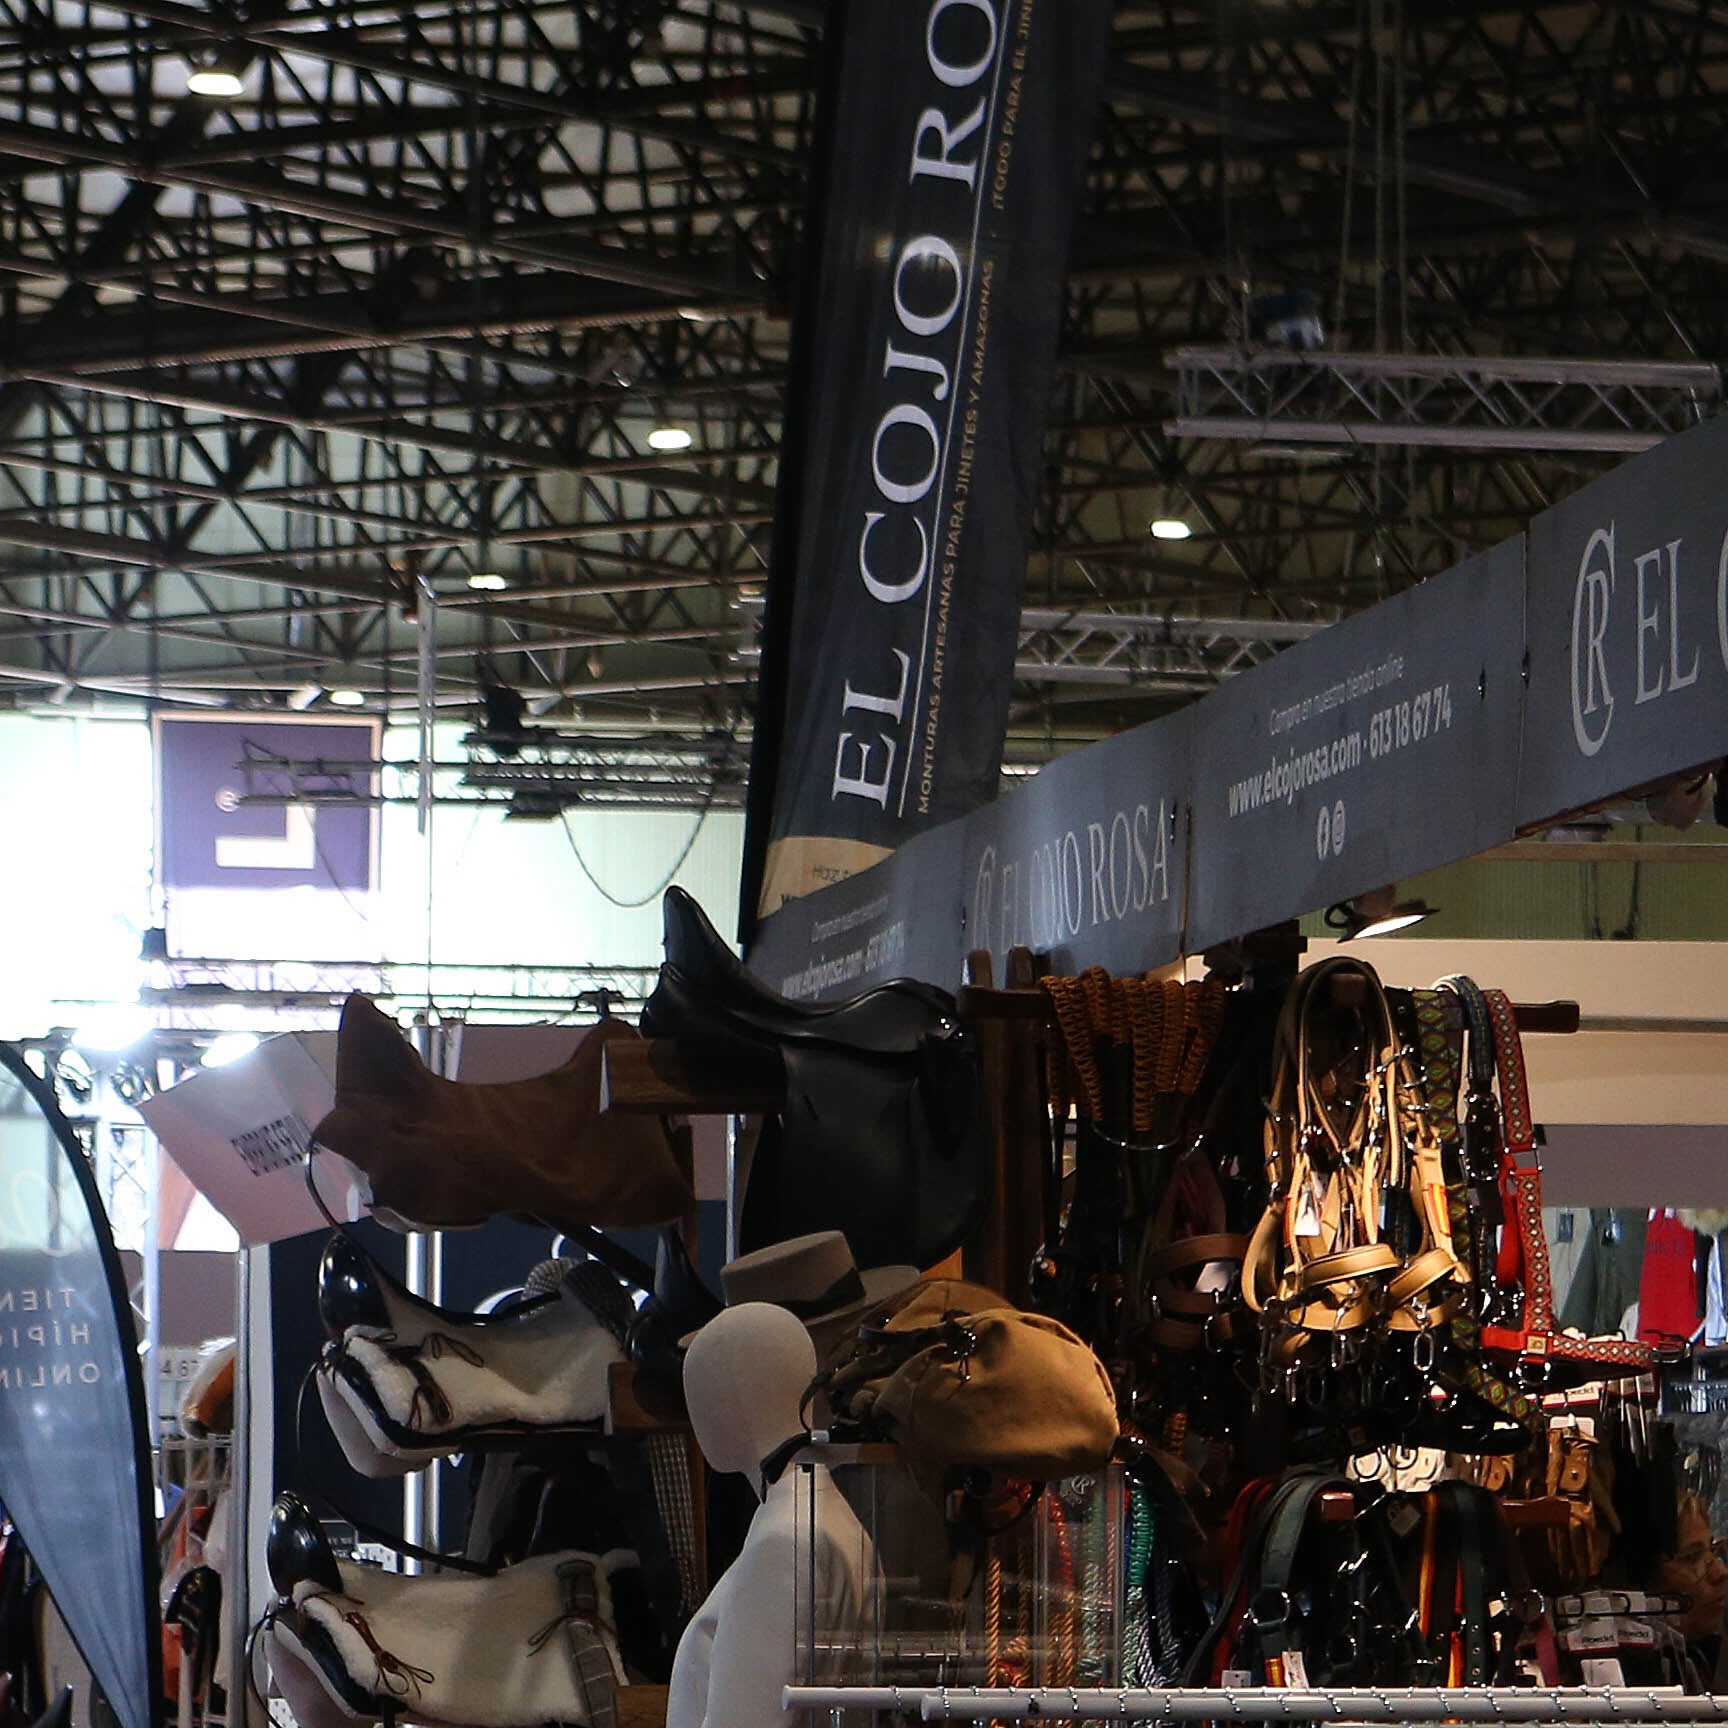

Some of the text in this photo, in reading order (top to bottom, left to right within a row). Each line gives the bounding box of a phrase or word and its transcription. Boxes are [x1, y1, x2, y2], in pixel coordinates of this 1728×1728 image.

[1002, 76, 1024, 137] PARA
[970, 261, 995, 386] AMAZONAS
[858, 233, 962, 605] COJO
[954, 408, 979, 495] JINETES
[945, 498, 967, 557] PARA
[931, 562, 956, 688] ARTESANAS
[1633, 538, 1701, 706] EL
[831, 646, 912, 810] EL
[917, 694, 942, 814] MONTURAS
[1227, 731, 1361, 819] www.elcojorosa.com
[1369, 708, 1393, 760] 613
[1087, 797, 1169, 926] ROSA
